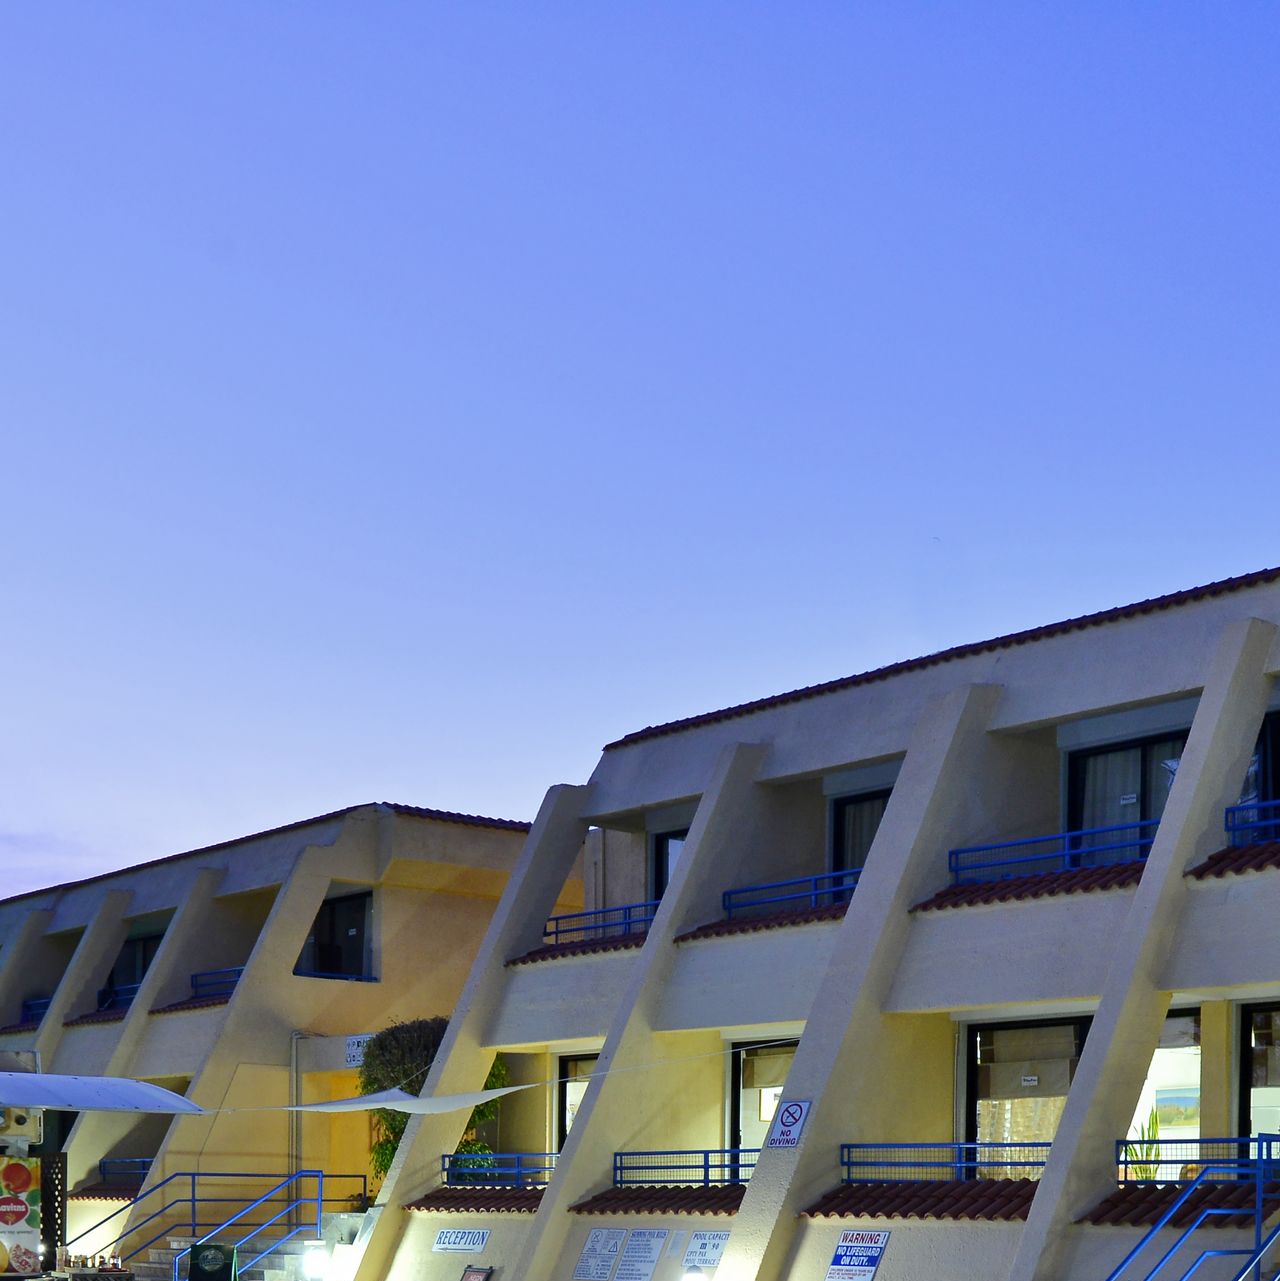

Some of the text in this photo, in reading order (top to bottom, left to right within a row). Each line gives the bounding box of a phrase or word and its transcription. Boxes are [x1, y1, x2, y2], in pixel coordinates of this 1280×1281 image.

[780, 1129, 791, 1137] NO
[770, 1138, 796, 1146] DIVING
[436, 1230, 488, 1246] RECEPTION
[692, 1232, 708, 1241] POOL
[841, 1232, 880, 1244] WARNING
[837, 1246, 880, 1256] NO LIFEGUARD
[841, 1256, 851, 1265] ON
